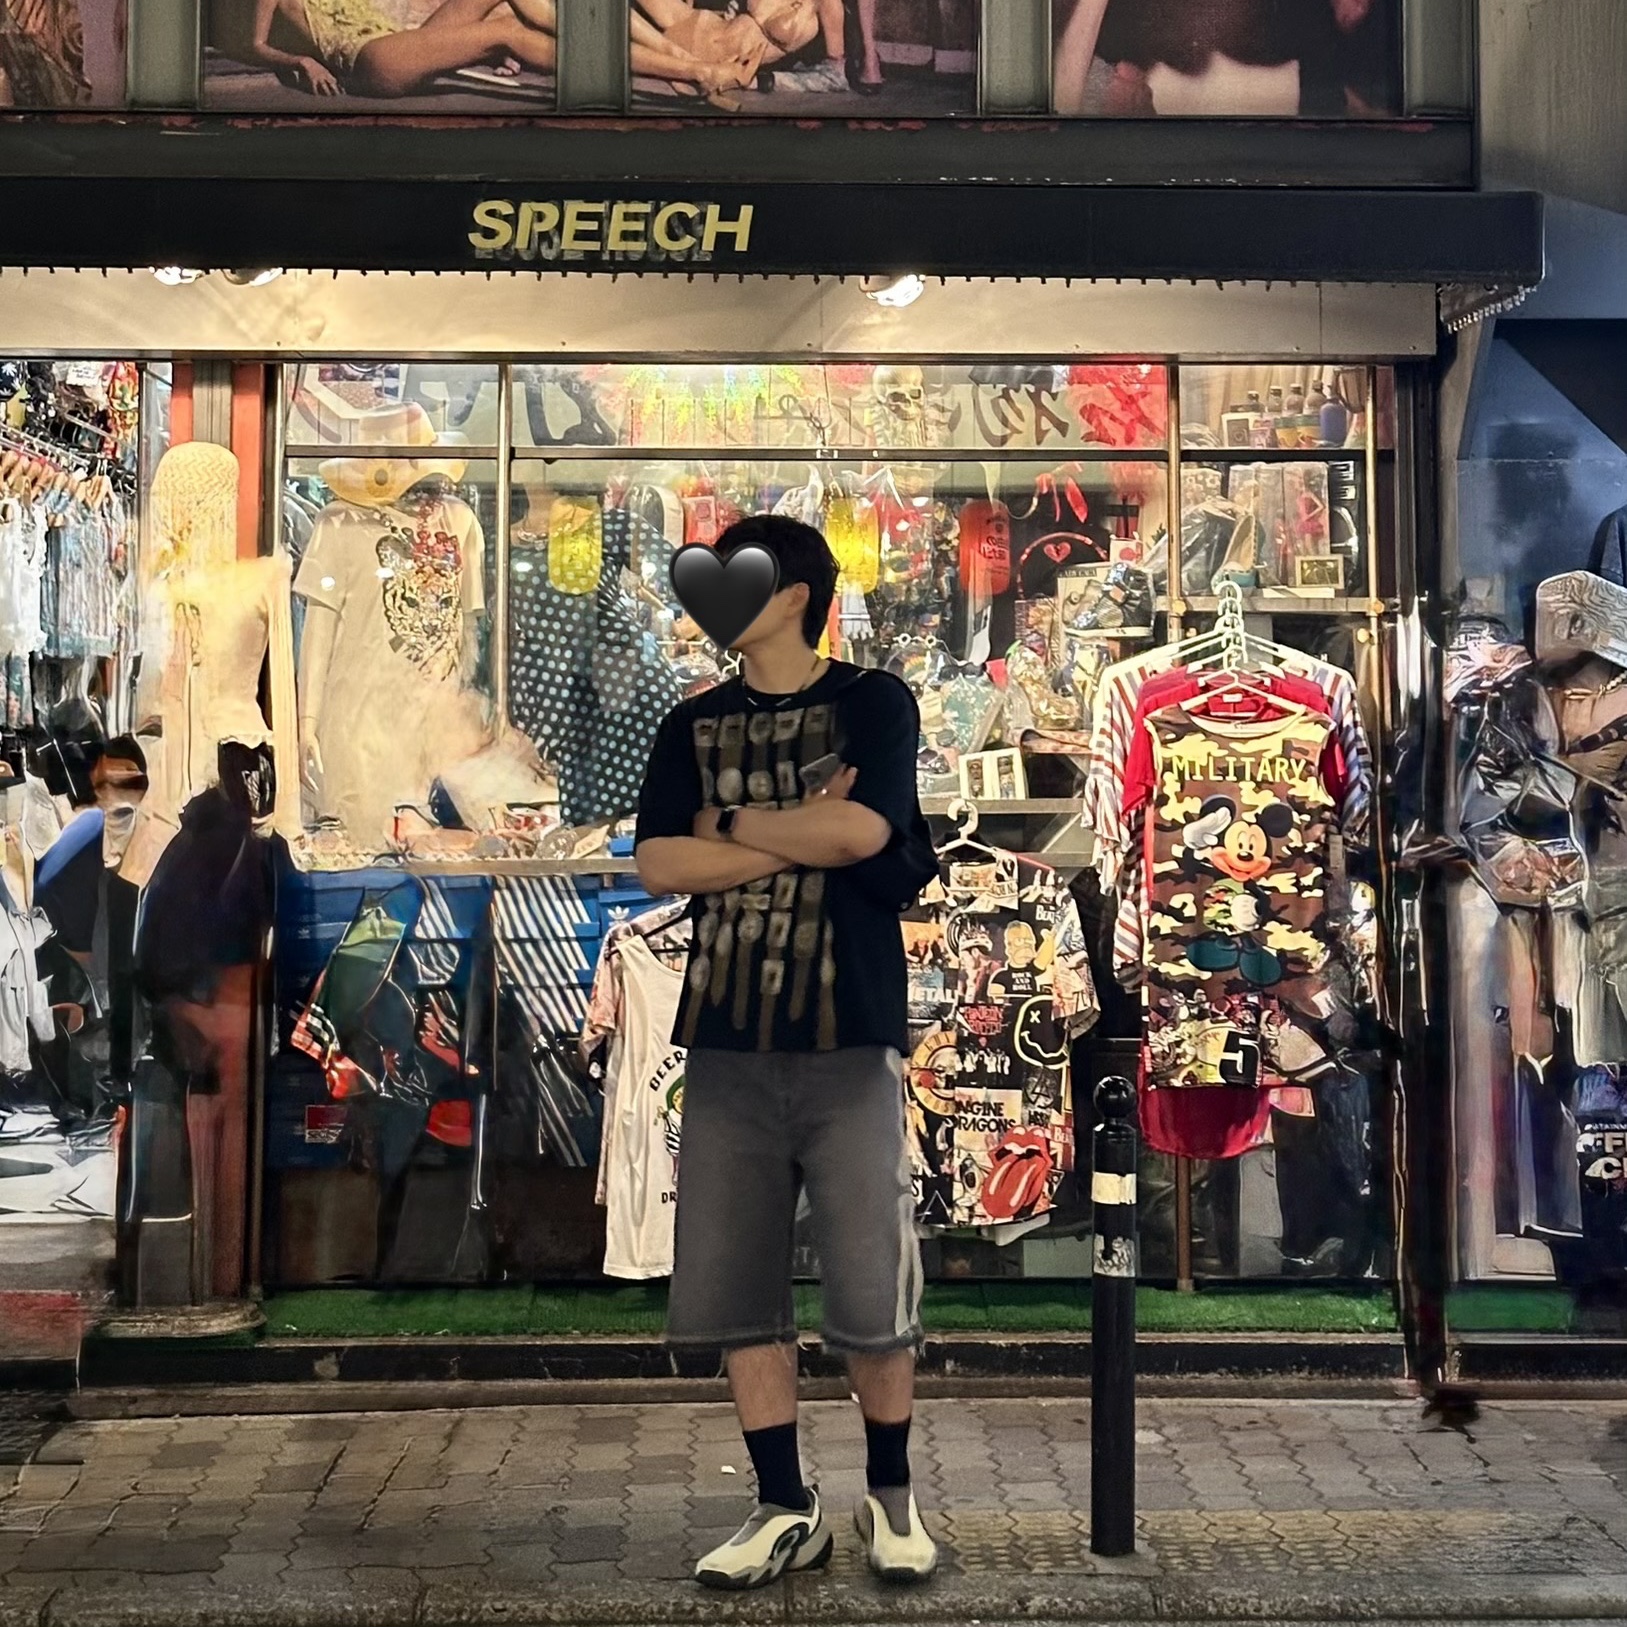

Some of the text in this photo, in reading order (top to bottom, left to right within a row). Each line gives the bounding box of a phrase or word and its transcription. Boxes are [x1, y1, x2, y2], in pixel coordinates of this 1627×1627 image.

[468, 199, 754, 252] SPEECH
[1172, 756, 1307, 783] MILITARY
[1219, 1030, 1260, 1085] 5
